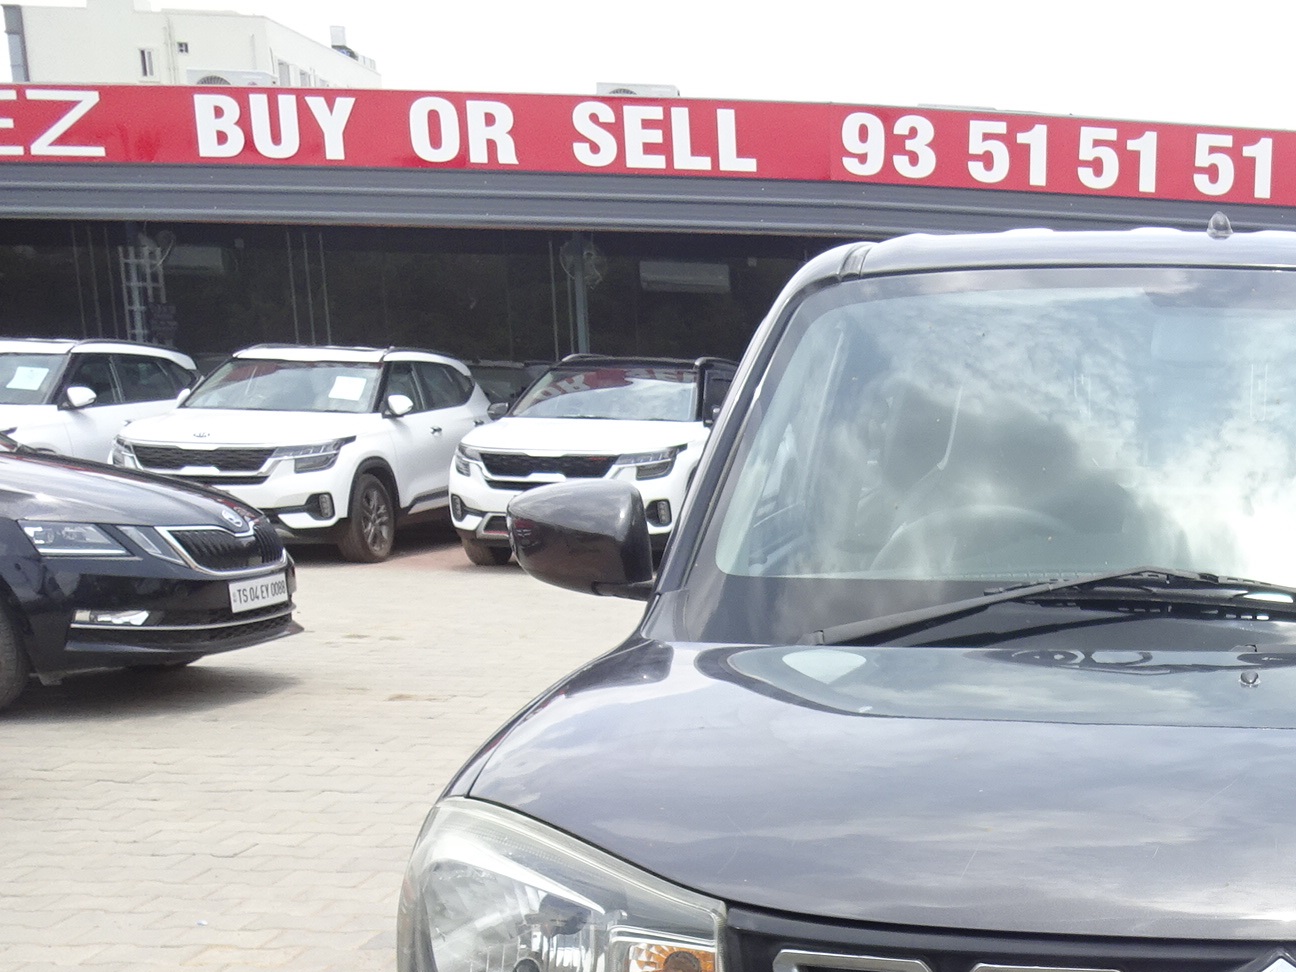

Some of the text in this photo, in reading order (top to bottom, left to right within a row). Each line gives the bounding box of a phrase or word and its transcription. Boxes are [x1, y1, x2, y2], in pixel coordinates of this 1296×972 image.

[193, 93, 356, 161] BUY
[408, 96, 520, 165] OR
[571, 100, 758, 173] SELL
[841, 111, 937, 179] 93
[967, 119, 1048, 187] 51
[1077, 126, 1158, 193] 51
[1193, 132, 1273, 199] 51
[236, 588, 249, 604] TS
[260, 583, 270, 600] EY
